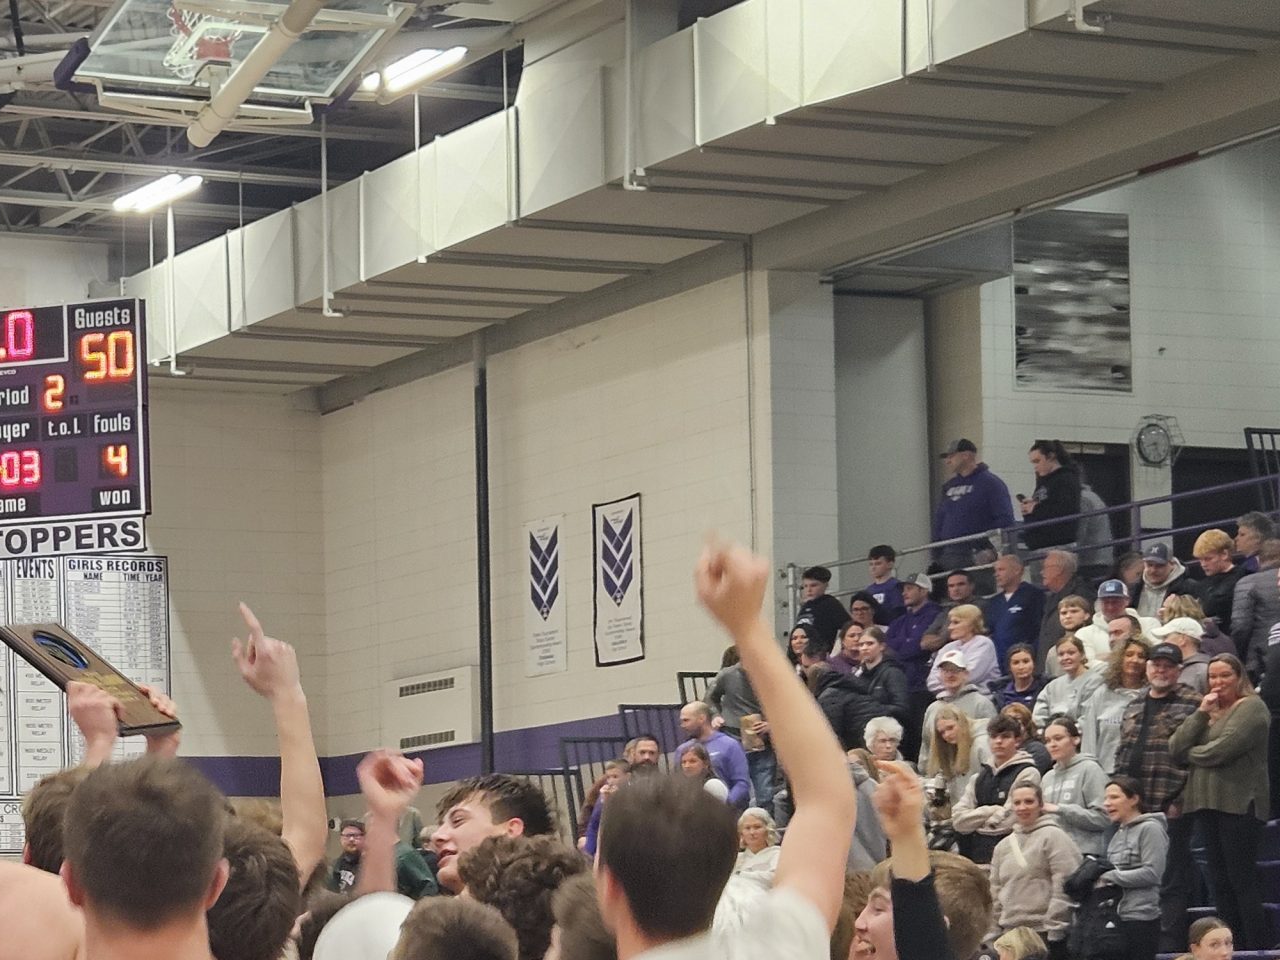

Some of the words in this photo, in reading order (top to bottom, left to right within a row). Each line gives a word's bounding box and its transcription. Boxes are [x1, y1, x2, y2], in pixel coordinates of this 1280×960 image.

[75, 307, 131, 329] Guests
[81, 331, 134, 379] 50
[45, 375, 64, 409] 2
[94, 414, 131, 433] fouls
[107, 445, 127, 475] 4
[100, 489, 130, 506] won
[16, 559, 54, 579] EVENTS
[68, 559, 103, 571] GIRLS
[107, 560, 163, 572] RECORDS
[83, 572, 103, 580] NAME
[123, 573, 140, 581] TIME
[145, 573, 162, 581] YEAR
